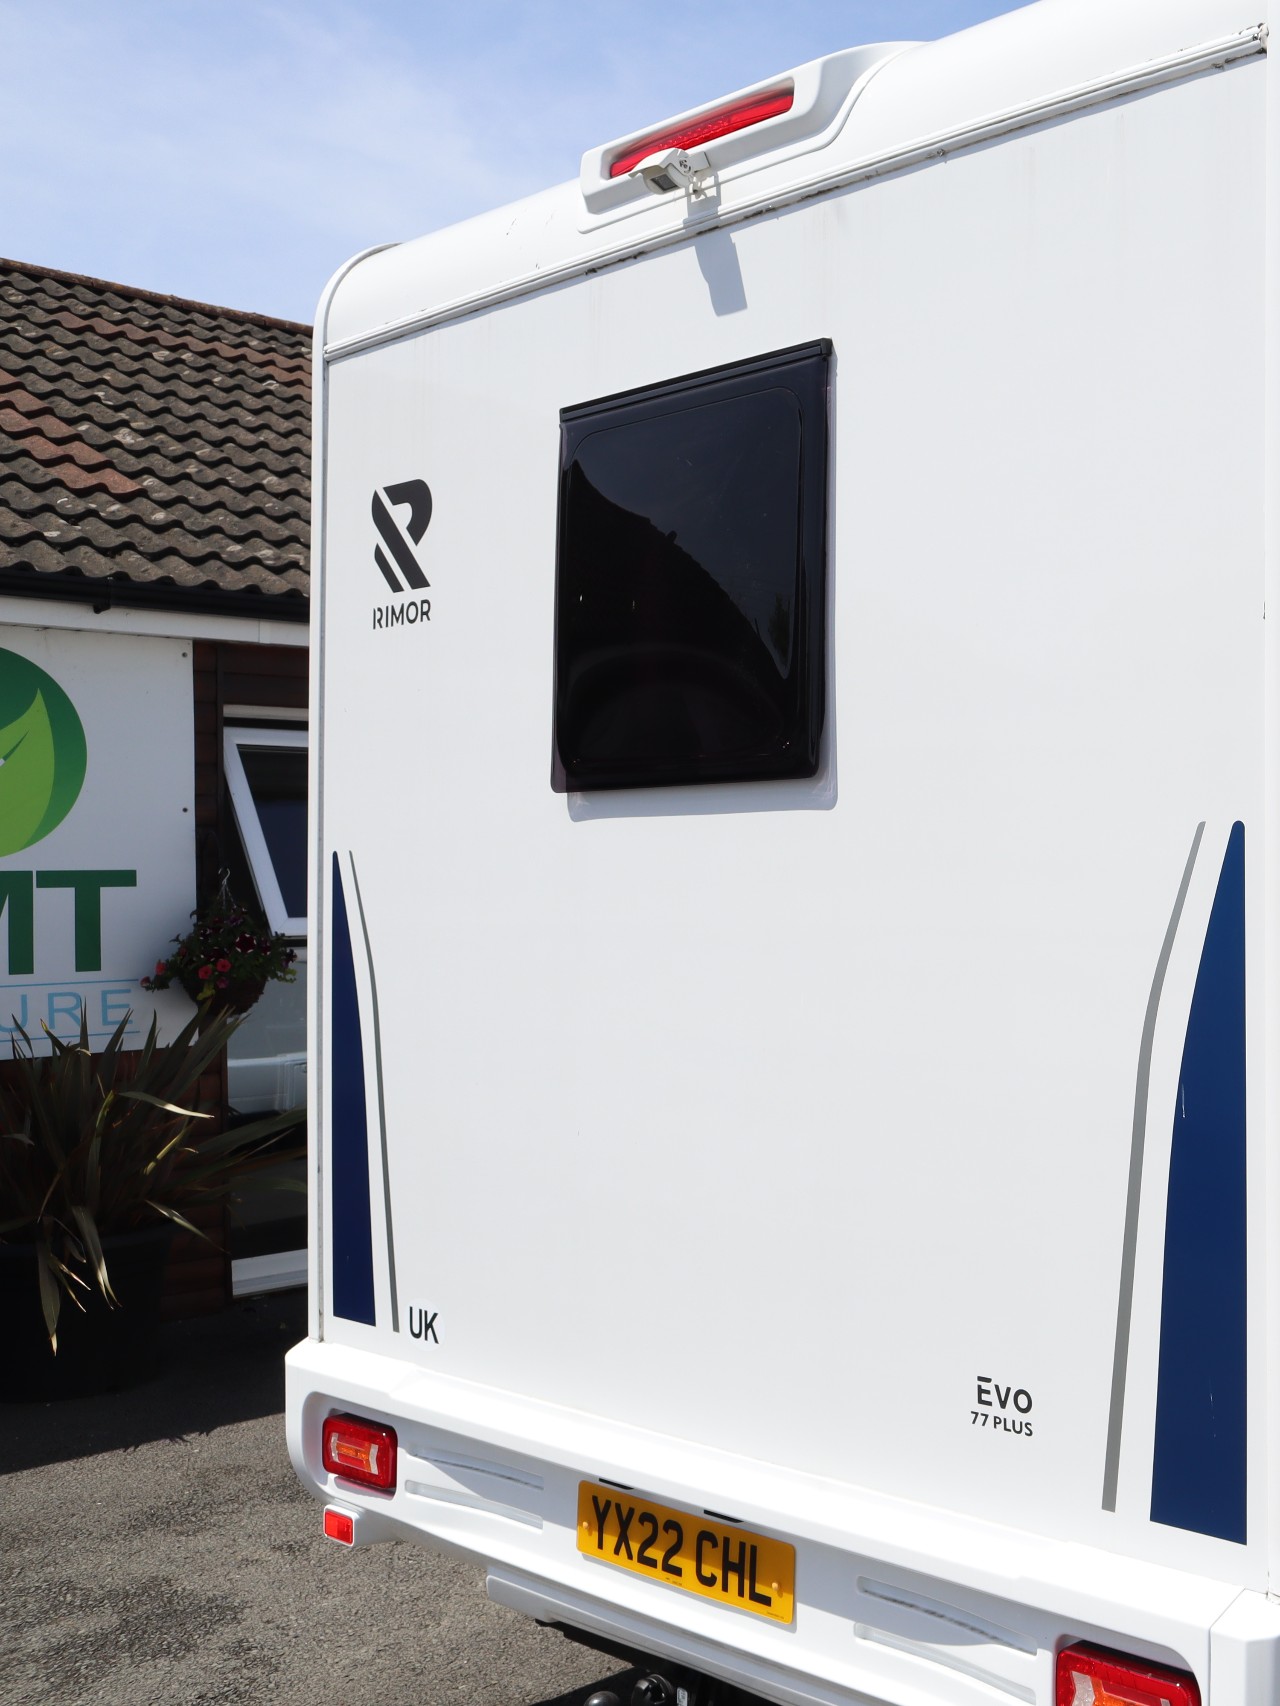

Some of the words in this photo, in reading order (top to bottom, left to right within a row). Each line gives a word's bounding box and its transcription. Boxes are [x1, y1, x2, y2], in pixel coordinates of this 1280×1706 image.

[372, 599, 431, 630] RIMOR
[409, 1306, 439, 1344] UK
[977, 1375, 1033, 1414] EVO
[970, 1410, 989, 1426] 77
[993, 1415, 1033, 1436] PLUS
[591, 1495, 683, 1577] YX22
[695, 1530, 772, 1607] CHL
